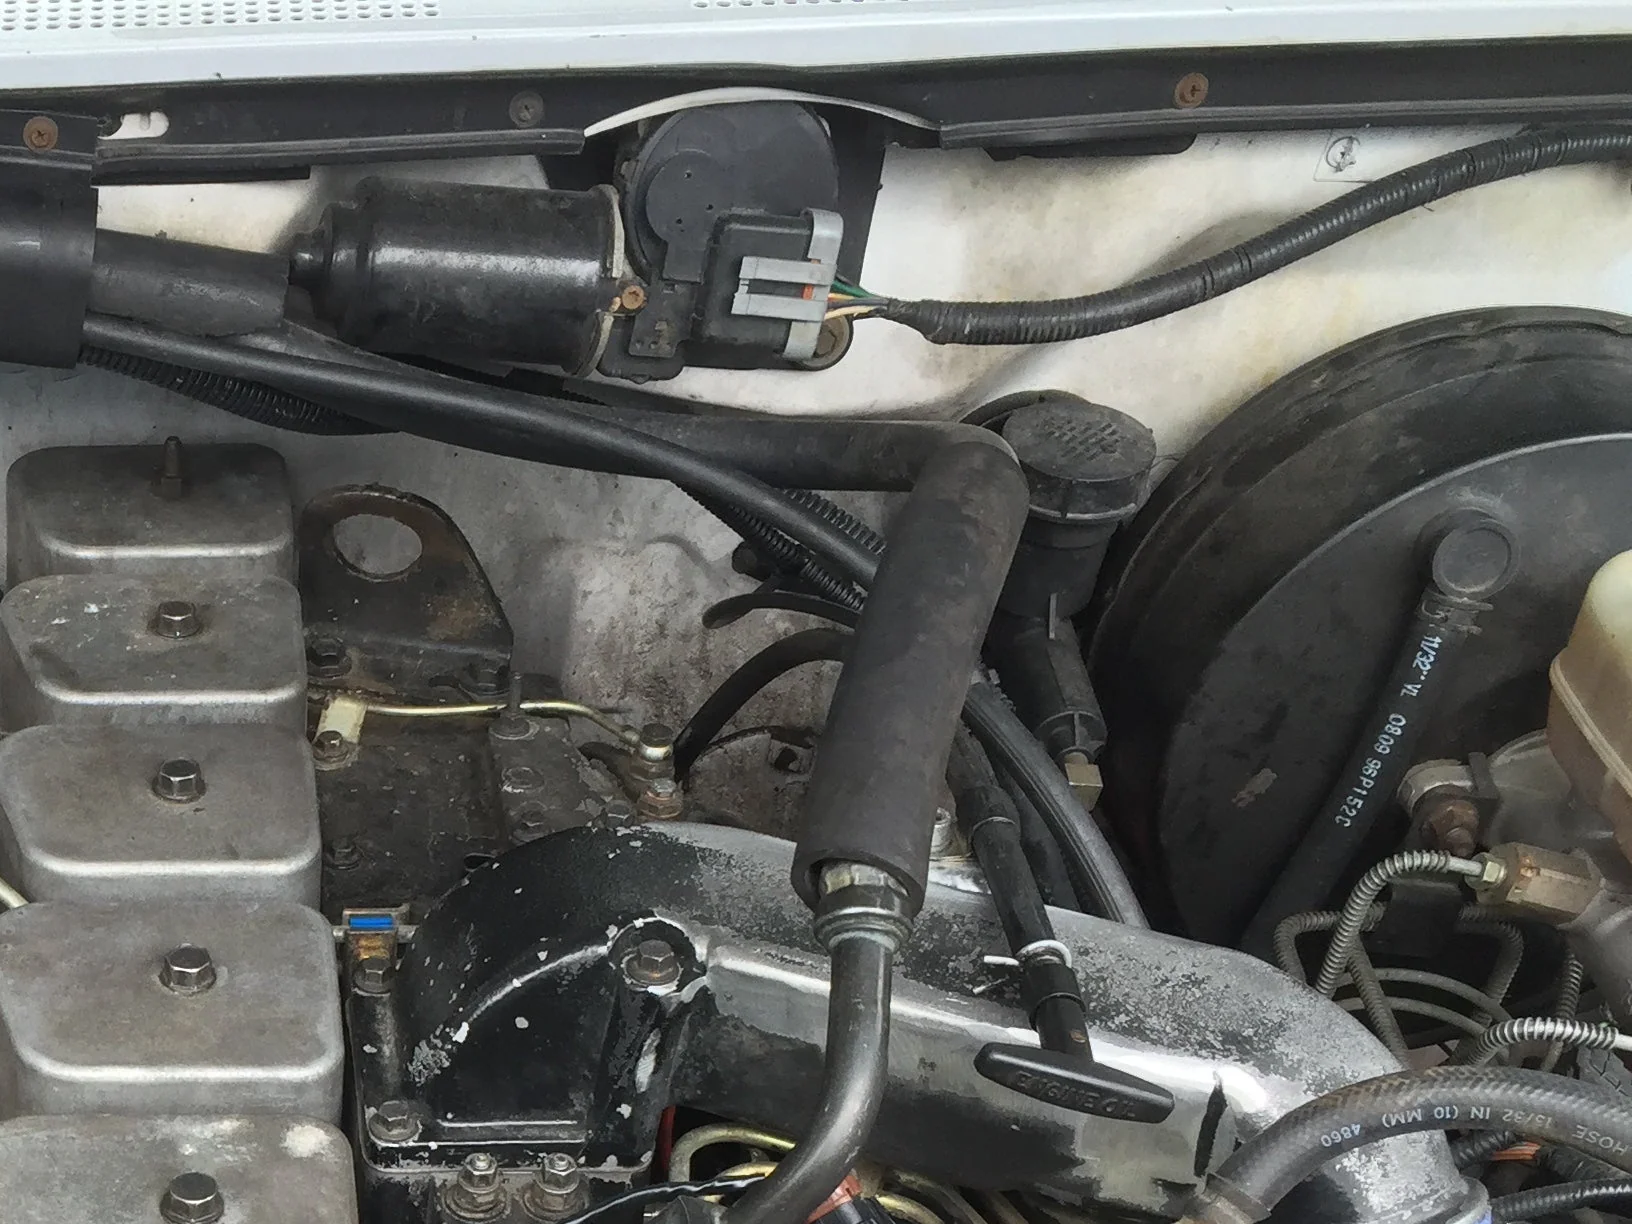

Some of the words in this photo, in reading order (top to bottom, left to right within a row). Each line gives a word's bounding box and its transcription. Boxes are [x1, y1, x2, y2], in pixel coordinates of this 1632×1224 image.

[1381, 1108, 1423, 1129] MM)
[1469, 1105, 1492, 1120] IN
[1320, 1122, 1362, 1148] 4860
[1571, 1123, 1631, 1156] HOSE
